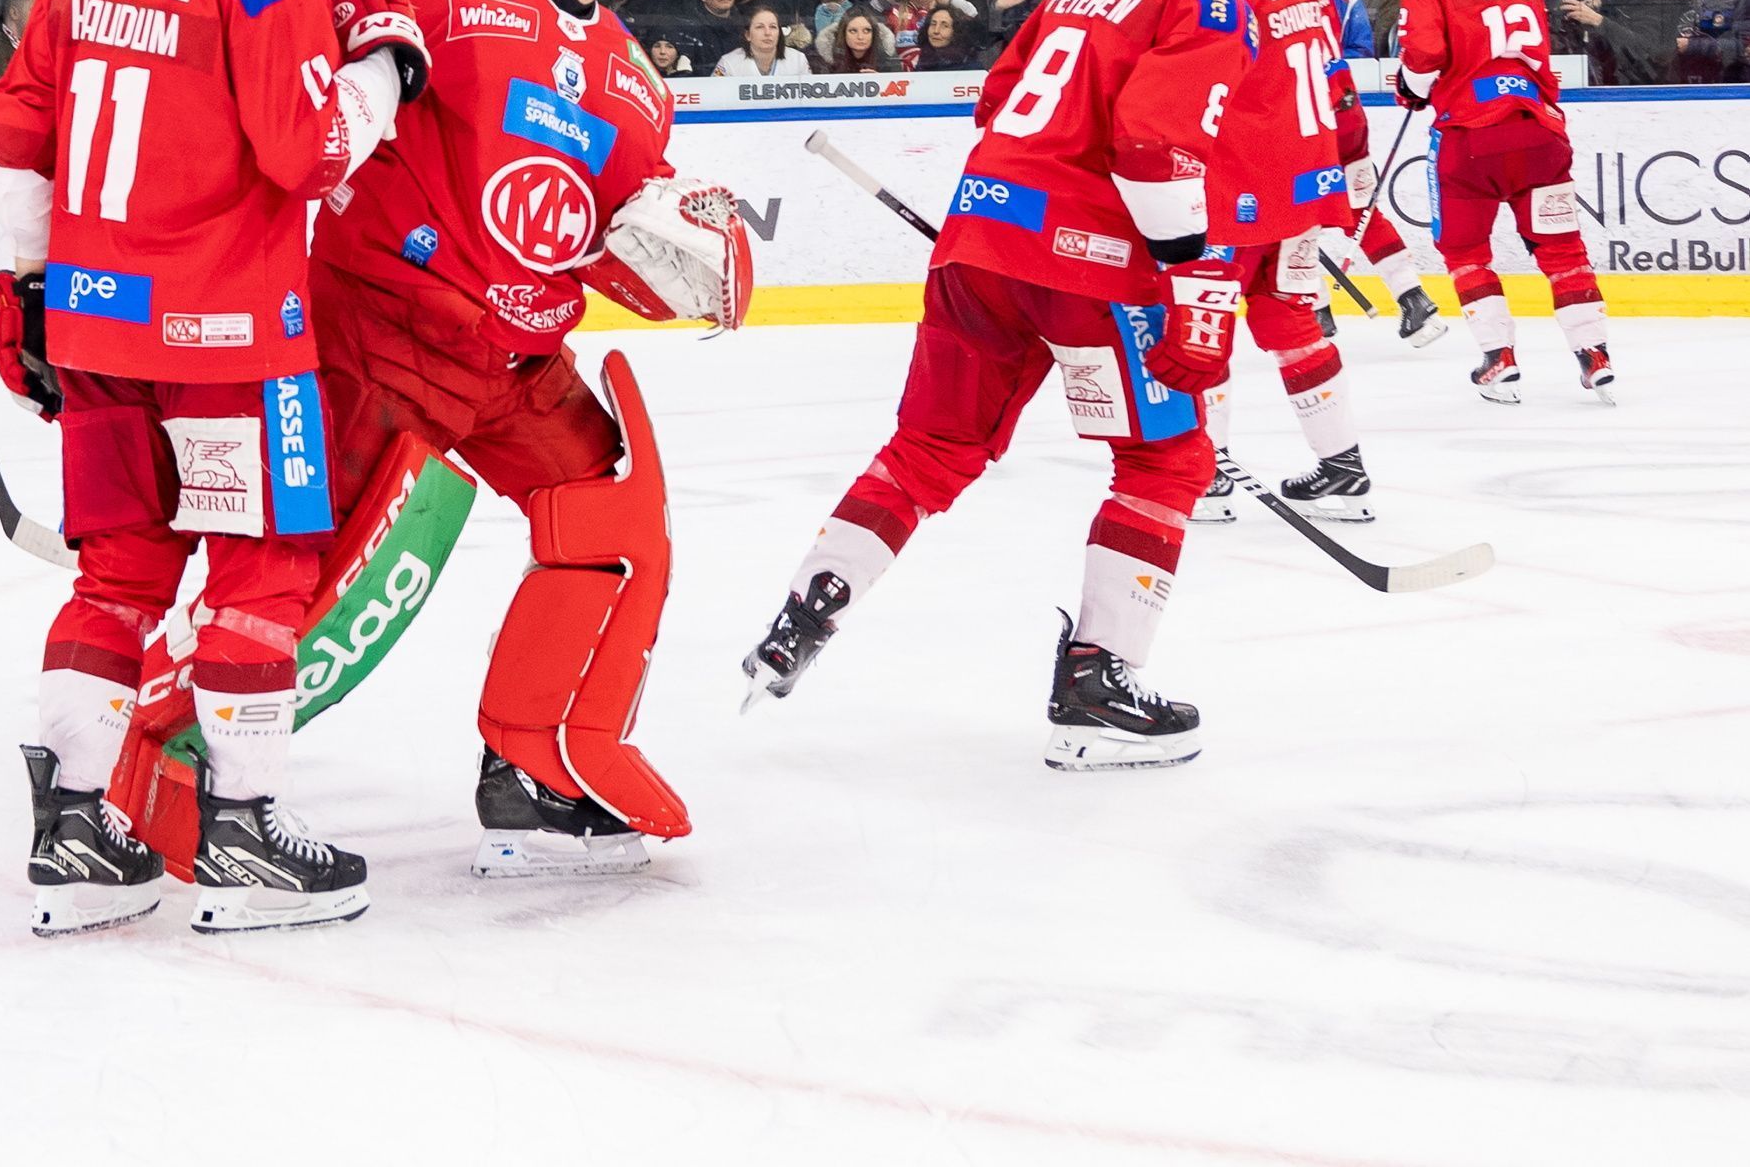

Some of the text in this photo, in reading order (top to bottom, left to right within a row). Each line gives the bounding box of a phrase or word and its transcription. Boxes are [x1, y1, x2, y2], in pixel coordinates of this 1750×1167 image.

[459, 3, 531, 33] win2day
[1480, 3, 1544, 73] 12
[738, 78, 912, 101] ELEKTROLAND.AT
[992, 25, 1088, 139] 8
[67, 56, 152, 223] 11
[1608, 237, 1750, 272] Red Bul
[294, 548, 433, 710] elag
[213, 852, 259, 886] CCM
